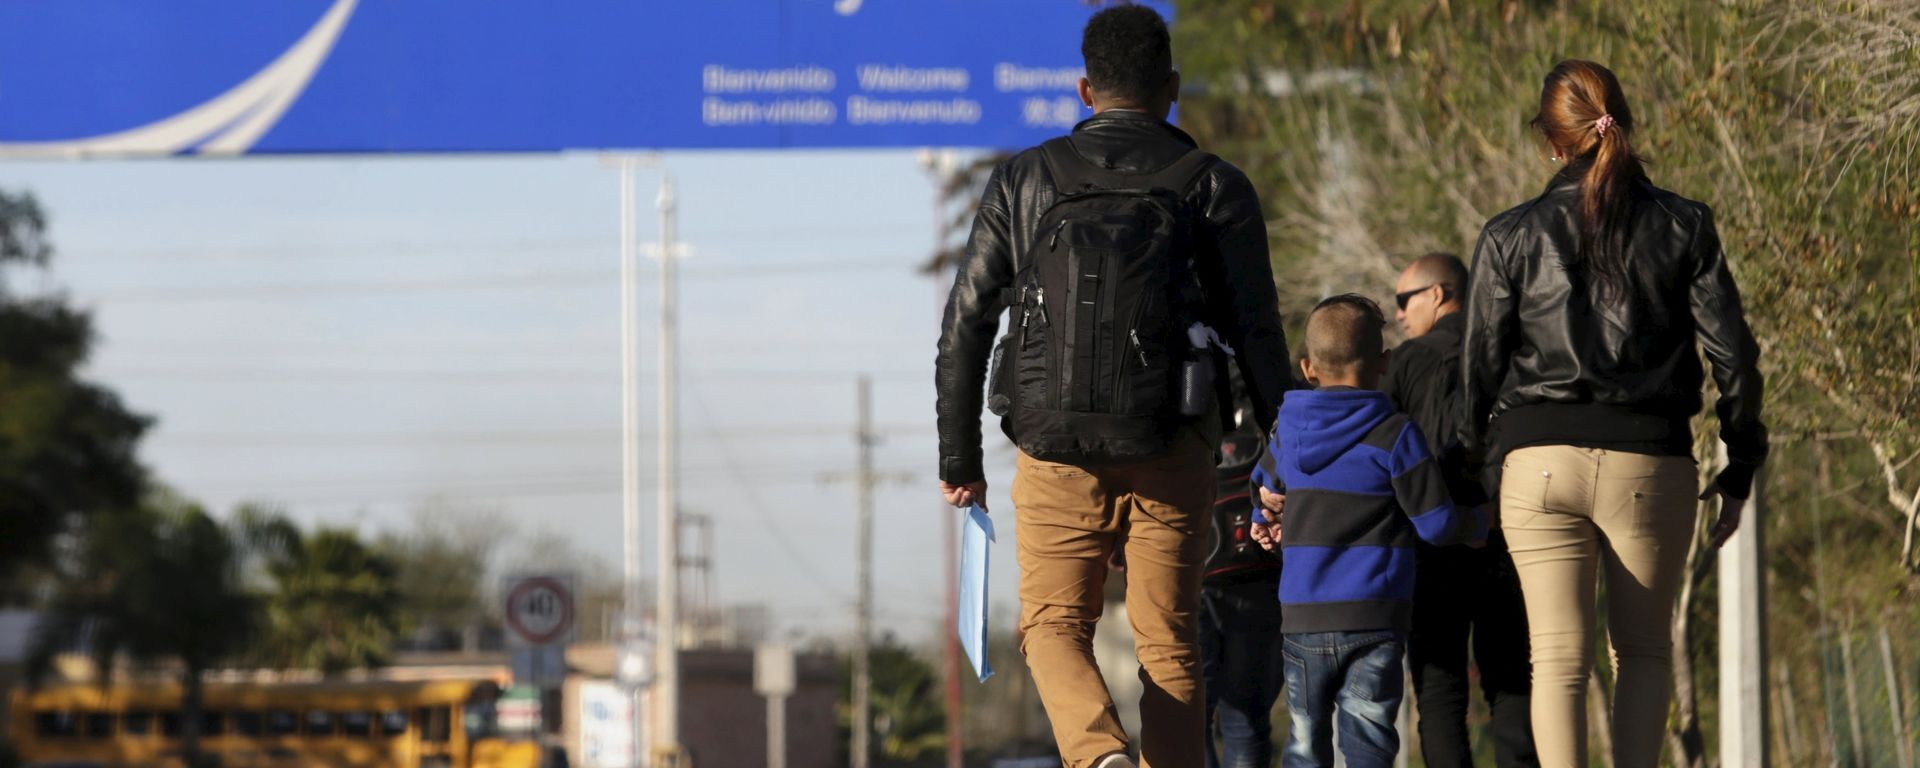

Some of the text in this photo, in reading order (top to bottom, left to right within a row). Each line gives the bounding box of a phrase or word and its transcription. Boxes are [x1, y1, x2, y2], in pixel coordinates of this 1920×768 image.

[703, 65, 835, 93] Bienvenido
[857, 65, 969, 91] Welcome
[524, 594, 553, 617] 40
